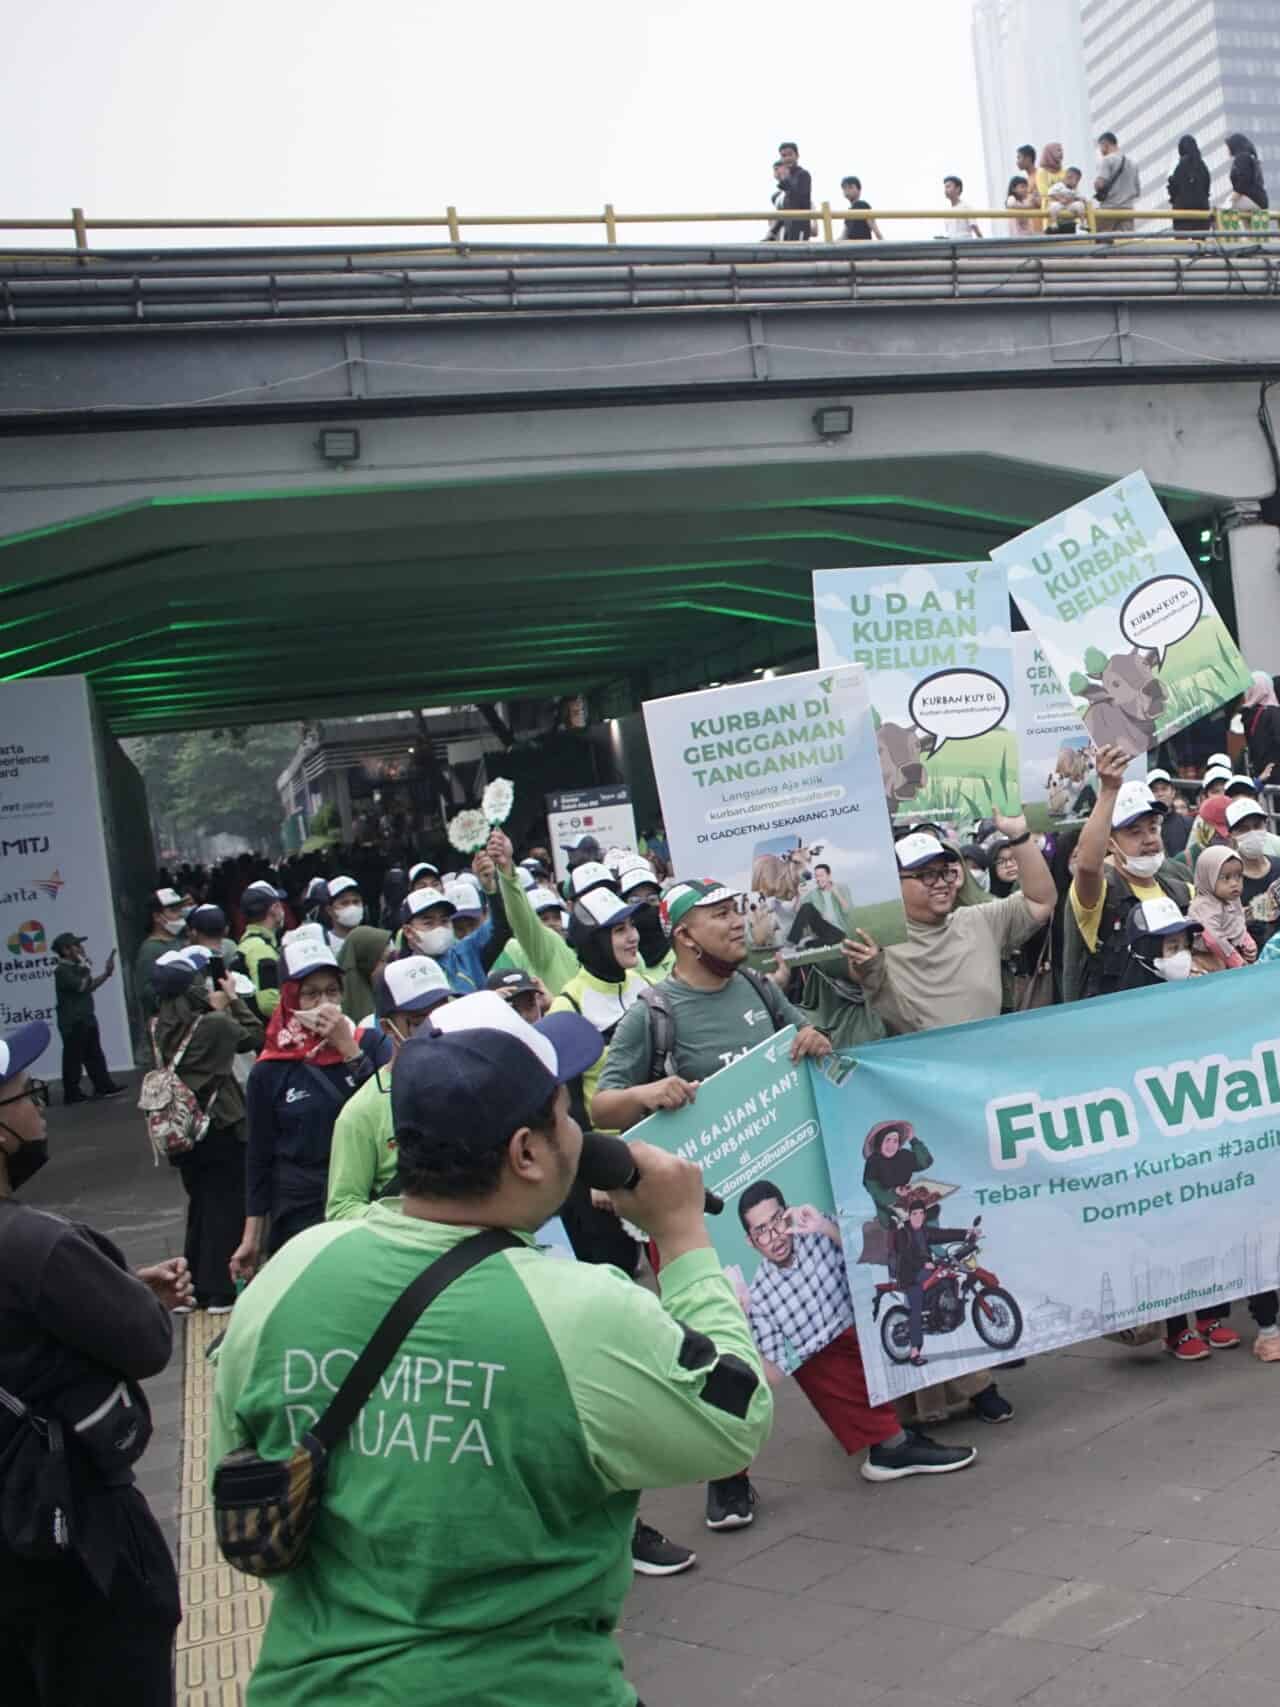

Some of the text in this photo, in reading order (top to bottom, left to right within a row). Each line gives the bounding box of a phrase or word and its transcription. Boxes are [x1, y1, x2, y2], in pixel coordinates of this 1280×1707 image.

[1032, 507, 1135, 576] UDAH
[1045, 530, 1147, 600] KURBAN
[850, 588, 976, 617] UDAH
[1130, 604, 1163, 628] KURBAN
[852, 615, 977, 644] KURBAN
[691, 697, 830, 739] KURBAN DI
[922, 695, 962, 707] KURBAN
[683, 719, 846, 765] GENGGAMAN
[722, 785, 778, 803] Langsung
[696, 803, 860, 844] DI GADGETMU SEKARANG JUGA!
[758, 1070, 800, 1108] KAN?
[995, 1094, 1130, 1161] Fun
[976, 1179, 1042, 1207] Tebar
[1048, 1167, 1129, 1196] Hewan
[1134, 1148, 1213, 1177] Kurban
[1082, 1172, 1256, 1224] Dompet Dhuafa
[283, 1348, 505, 1410] DOMPET
[284, 1403, 495, 1467] DUAFA
